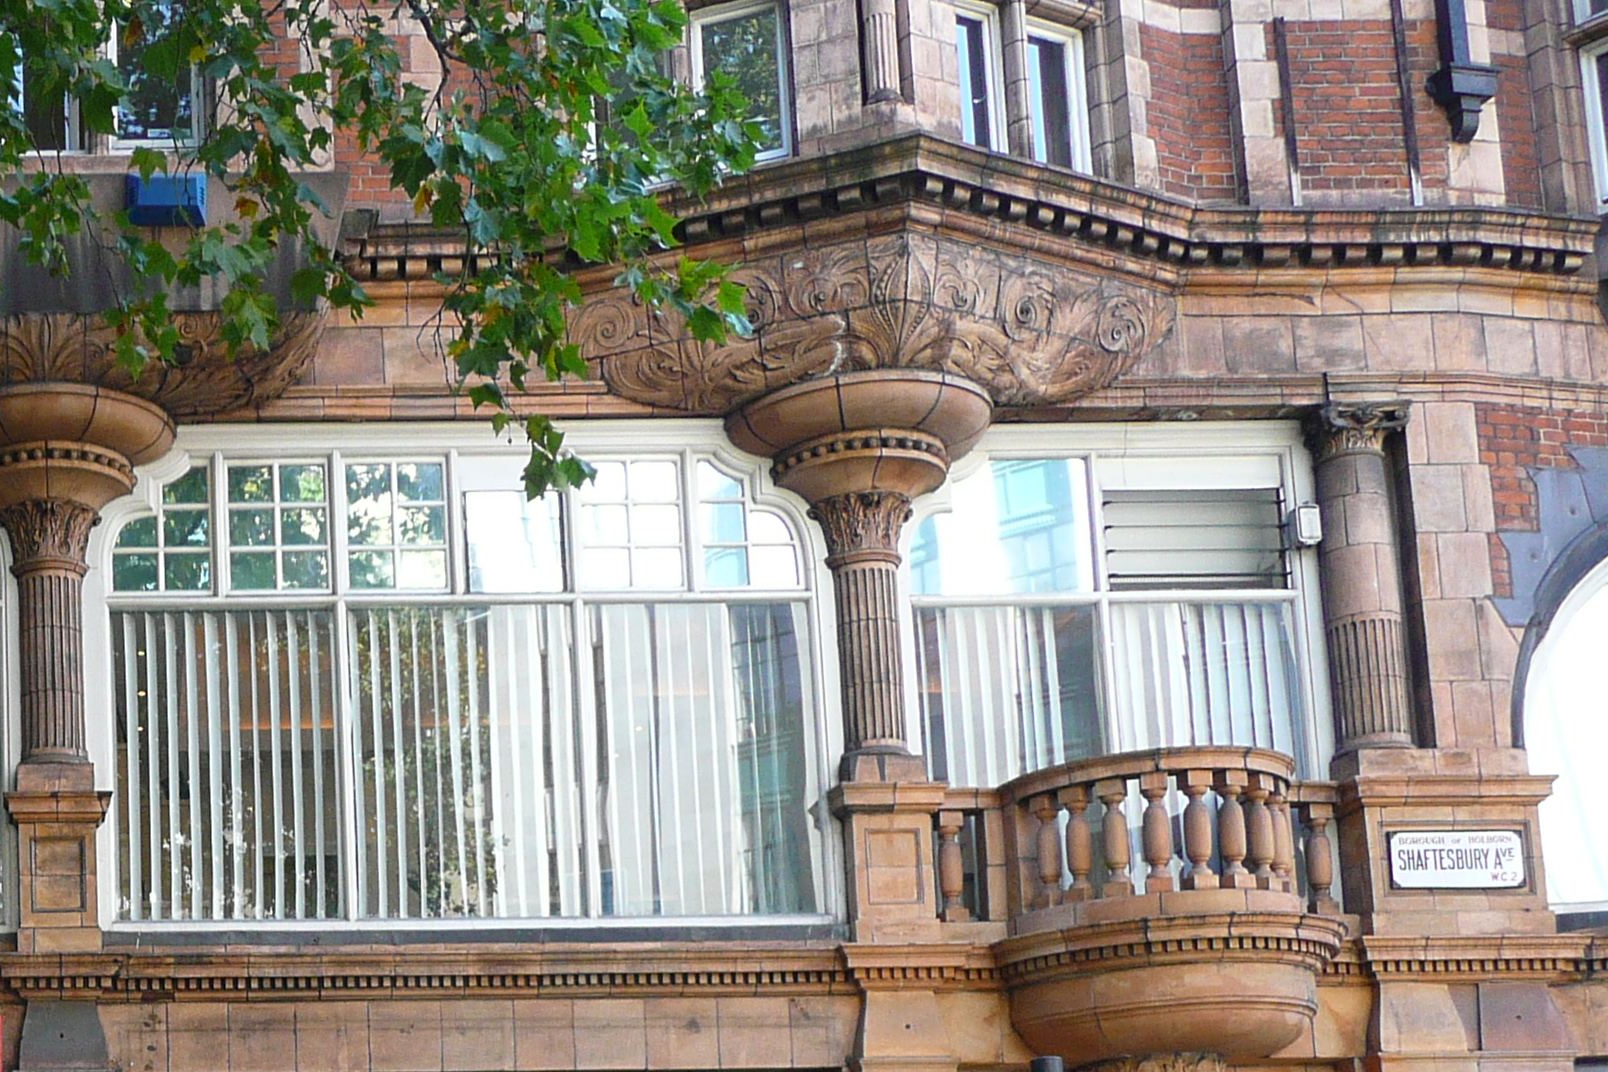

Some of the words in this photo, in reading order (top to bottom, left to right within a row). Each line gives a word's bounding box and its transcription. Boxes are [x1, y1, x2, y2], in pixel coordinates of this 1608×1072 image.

[1398, 836, 1445, 846] BOROUGH
[1467, 835, 1512, 844] HOLBORN
[1397, 848, 1490, 871] SHAFTESBURY
[1493, 847, 1515, 870] AVE
